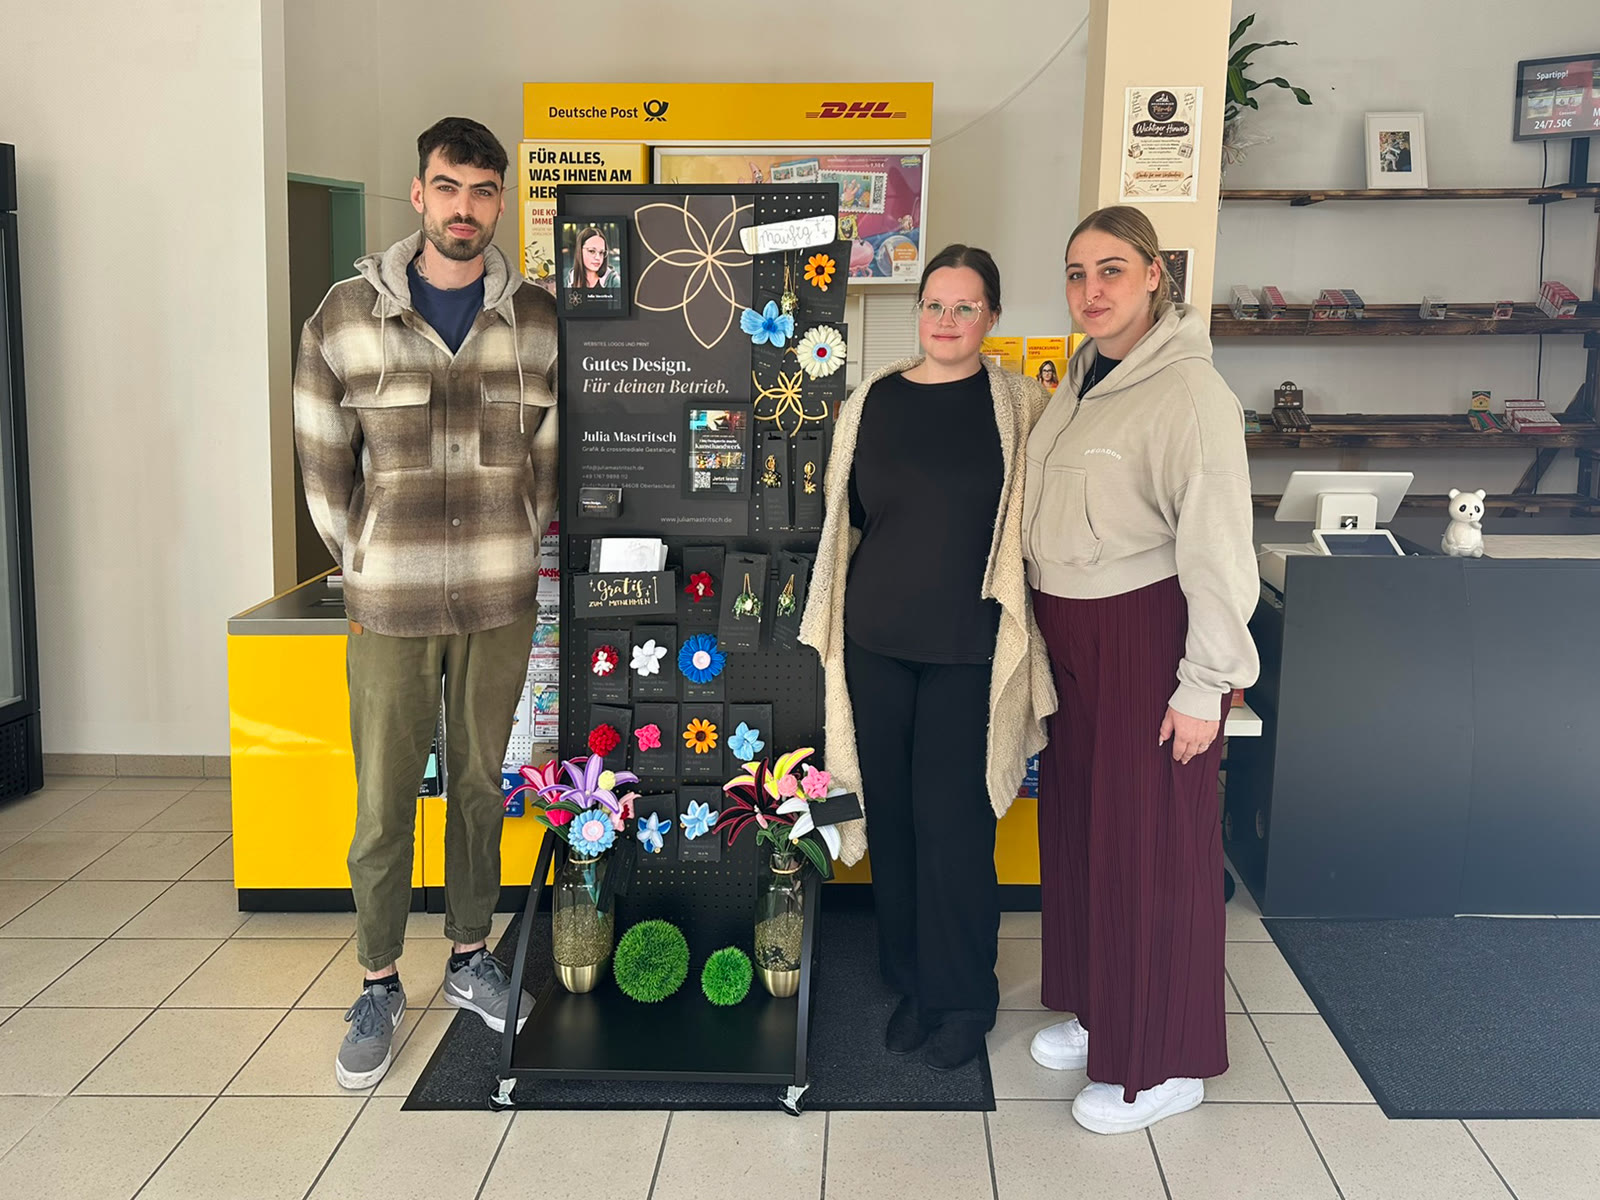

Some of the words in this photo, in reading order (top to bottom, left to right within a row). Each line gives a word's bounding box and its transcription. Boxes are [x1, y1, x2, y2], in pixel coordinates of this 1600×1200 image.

[1536, 69, 1569, 81] Spartipp!
[548, 105, 607, 118] Deutsche
[610, 106, 639, 118] Post
[818, 101, 893, 119] DHL
[1136, 122, 1166, 135] Wichtiger
[1166, 124, 1188, 134] Hinweis
[1534, 118, 1573, 130] 24/7.50€
[528, 147, 557, 165] FÜR
[559, 152, 605, 168] ALLES,
[529, 168, 561, 182] WAS
[563, 169, 607, 182] IHNEN
[609, 169, 632, 182] AM
[532, 208, 545, 216] DIE
[582, 356, 628, 372] Gutes
[632, 356, 692, 377] Design.
[582, 377, 611, 393] Für
[613, 378, 665, 394] deinen
[669, 378, 729, 394] Betrieb.
[582, 430, 610, 442] Julia
[613, 430, 677, 443] Mastritsch
[645, 446, 677, 455] Gestaltung
[660, 515, 733, 525] www.juliamastritsch.de
[597, 577, 647, 601] Gratis
[588, 600, 603, 608] ZUM
[608, 597, 651, 607] MITNEHMEN
